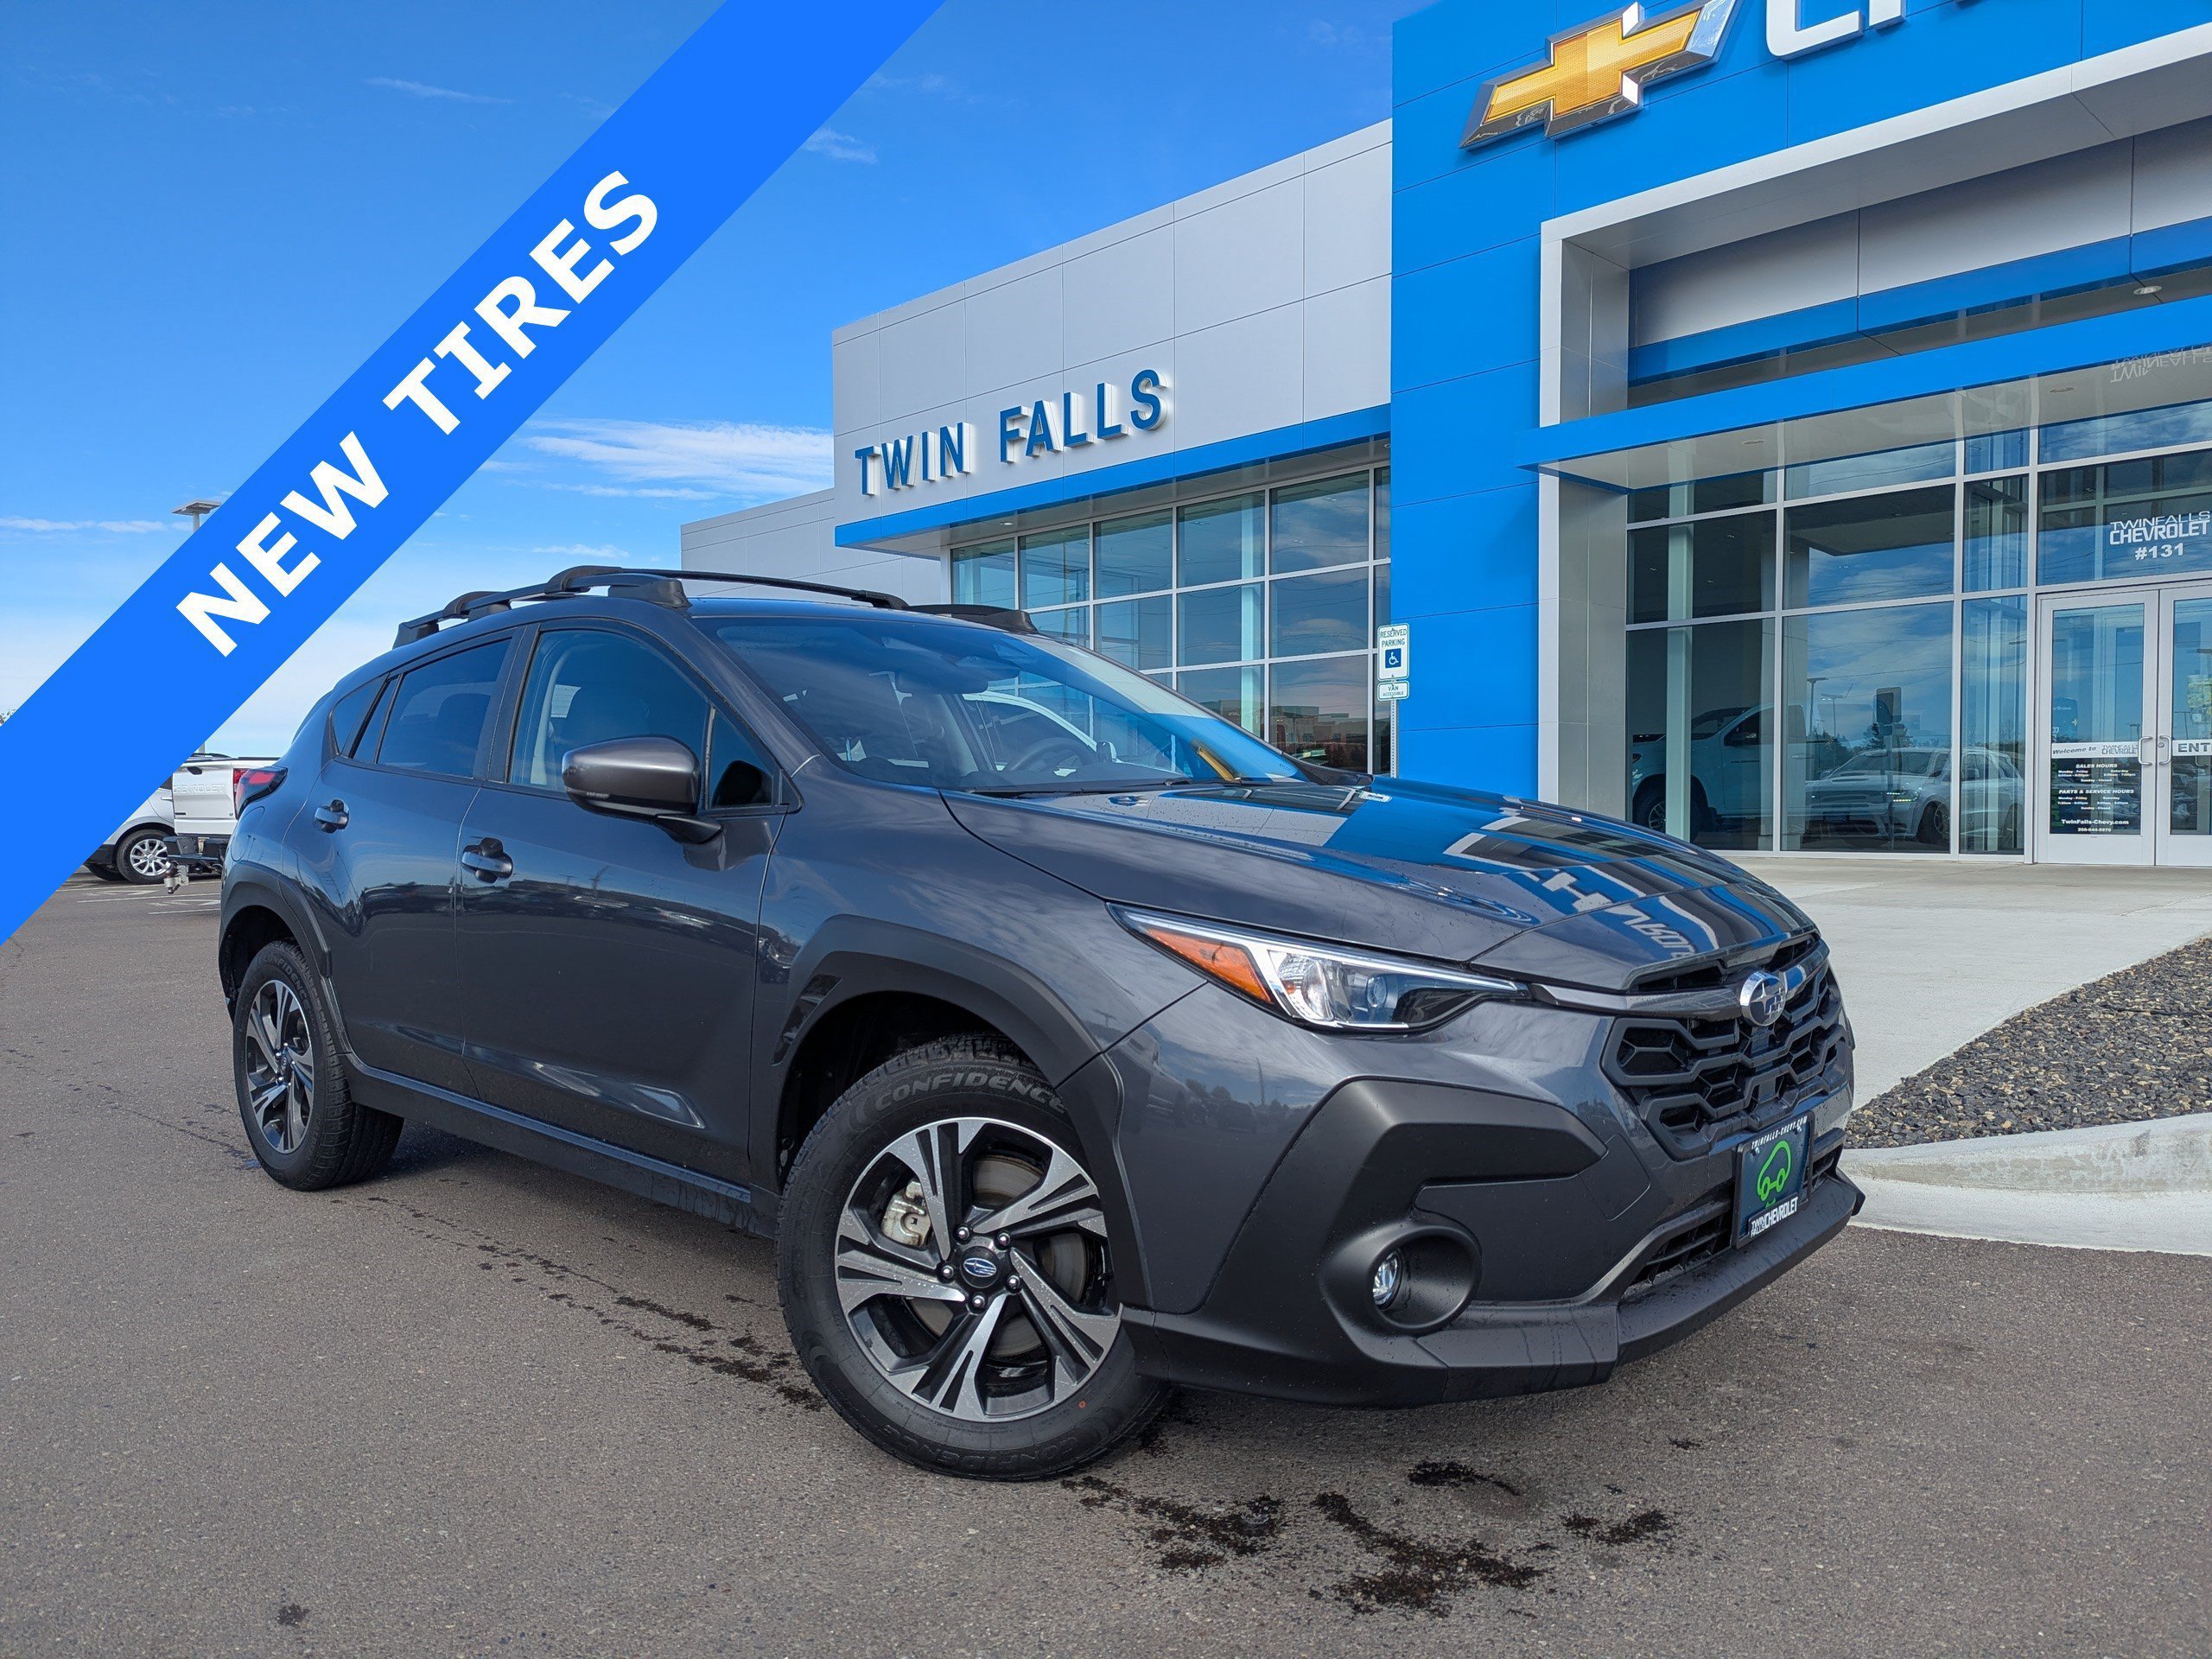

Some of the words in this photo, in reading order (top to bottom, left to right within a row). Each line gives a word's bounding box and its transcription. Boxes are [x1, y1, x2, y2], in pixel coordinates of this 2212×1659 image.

[855, 422, 971, 496] TWIN
[1000, 369, 1167, 464] FALLS
[2110, 511, 2210, 531] TWINFALLS
[2109, 520, 2209, 545] CHEVROLET
[2134, 543, 2183, 560] #131
[1380, 628, 1408, 639] RESERVED
[1382, 639, 1406, 647] PARKING
[2178, 742, 2211, 753] ENT
[875, 1071, 1068, 1114] CONFIDENCE
[1764, 1196, 1798, 1230] CHEVROLET
[1751, 1215, 1765, 1230] TWIN
[1751, 1223, 1765, 1238] FALLS
